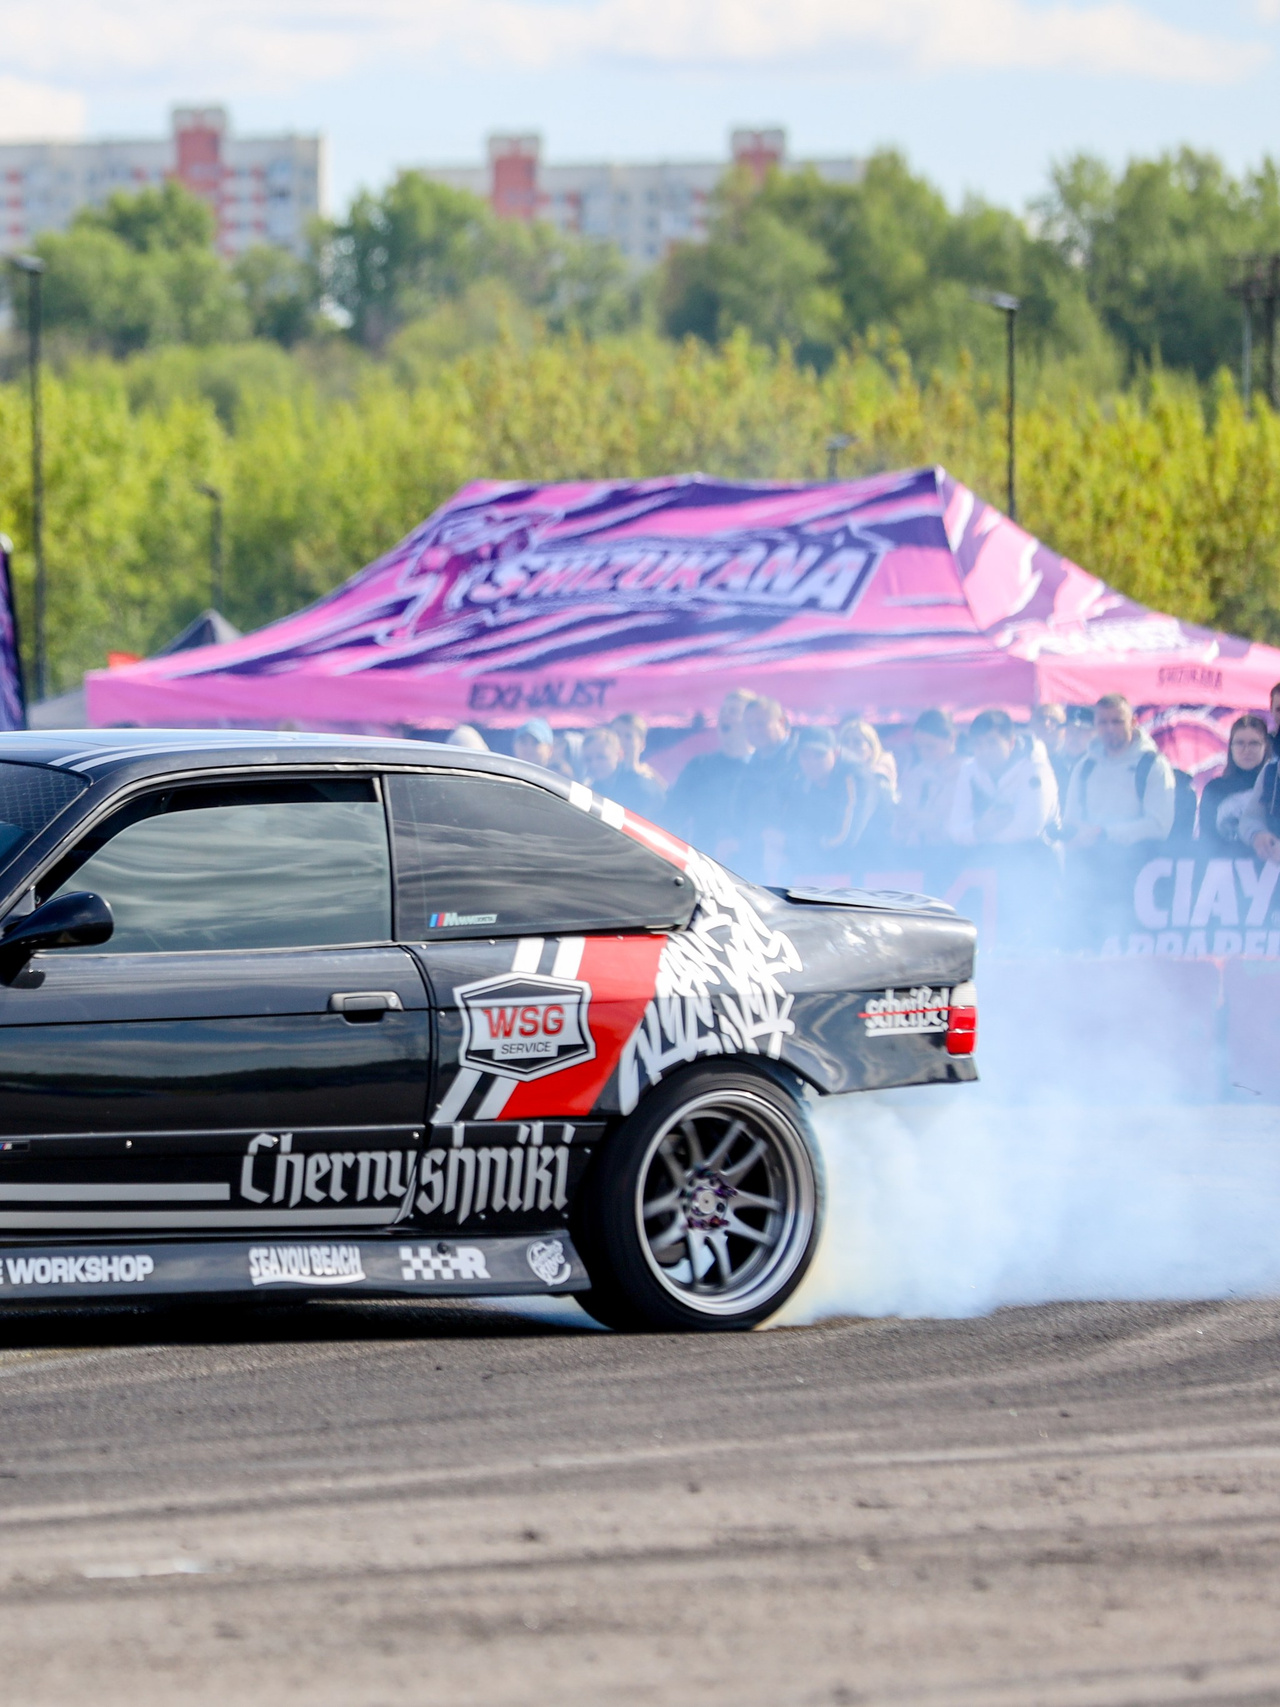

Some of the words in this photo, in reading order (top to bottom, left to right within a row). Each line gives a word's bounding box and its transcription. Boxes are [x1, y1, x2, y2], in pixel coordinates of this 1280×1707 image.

[482, 1004, 565, 1038] WSG
[501, 1042, 552, 1055] SERVICE
[240, 1121, 576, 1225] Chernyshniki
[6, 1255, 154, 1285] WORKSHOP
